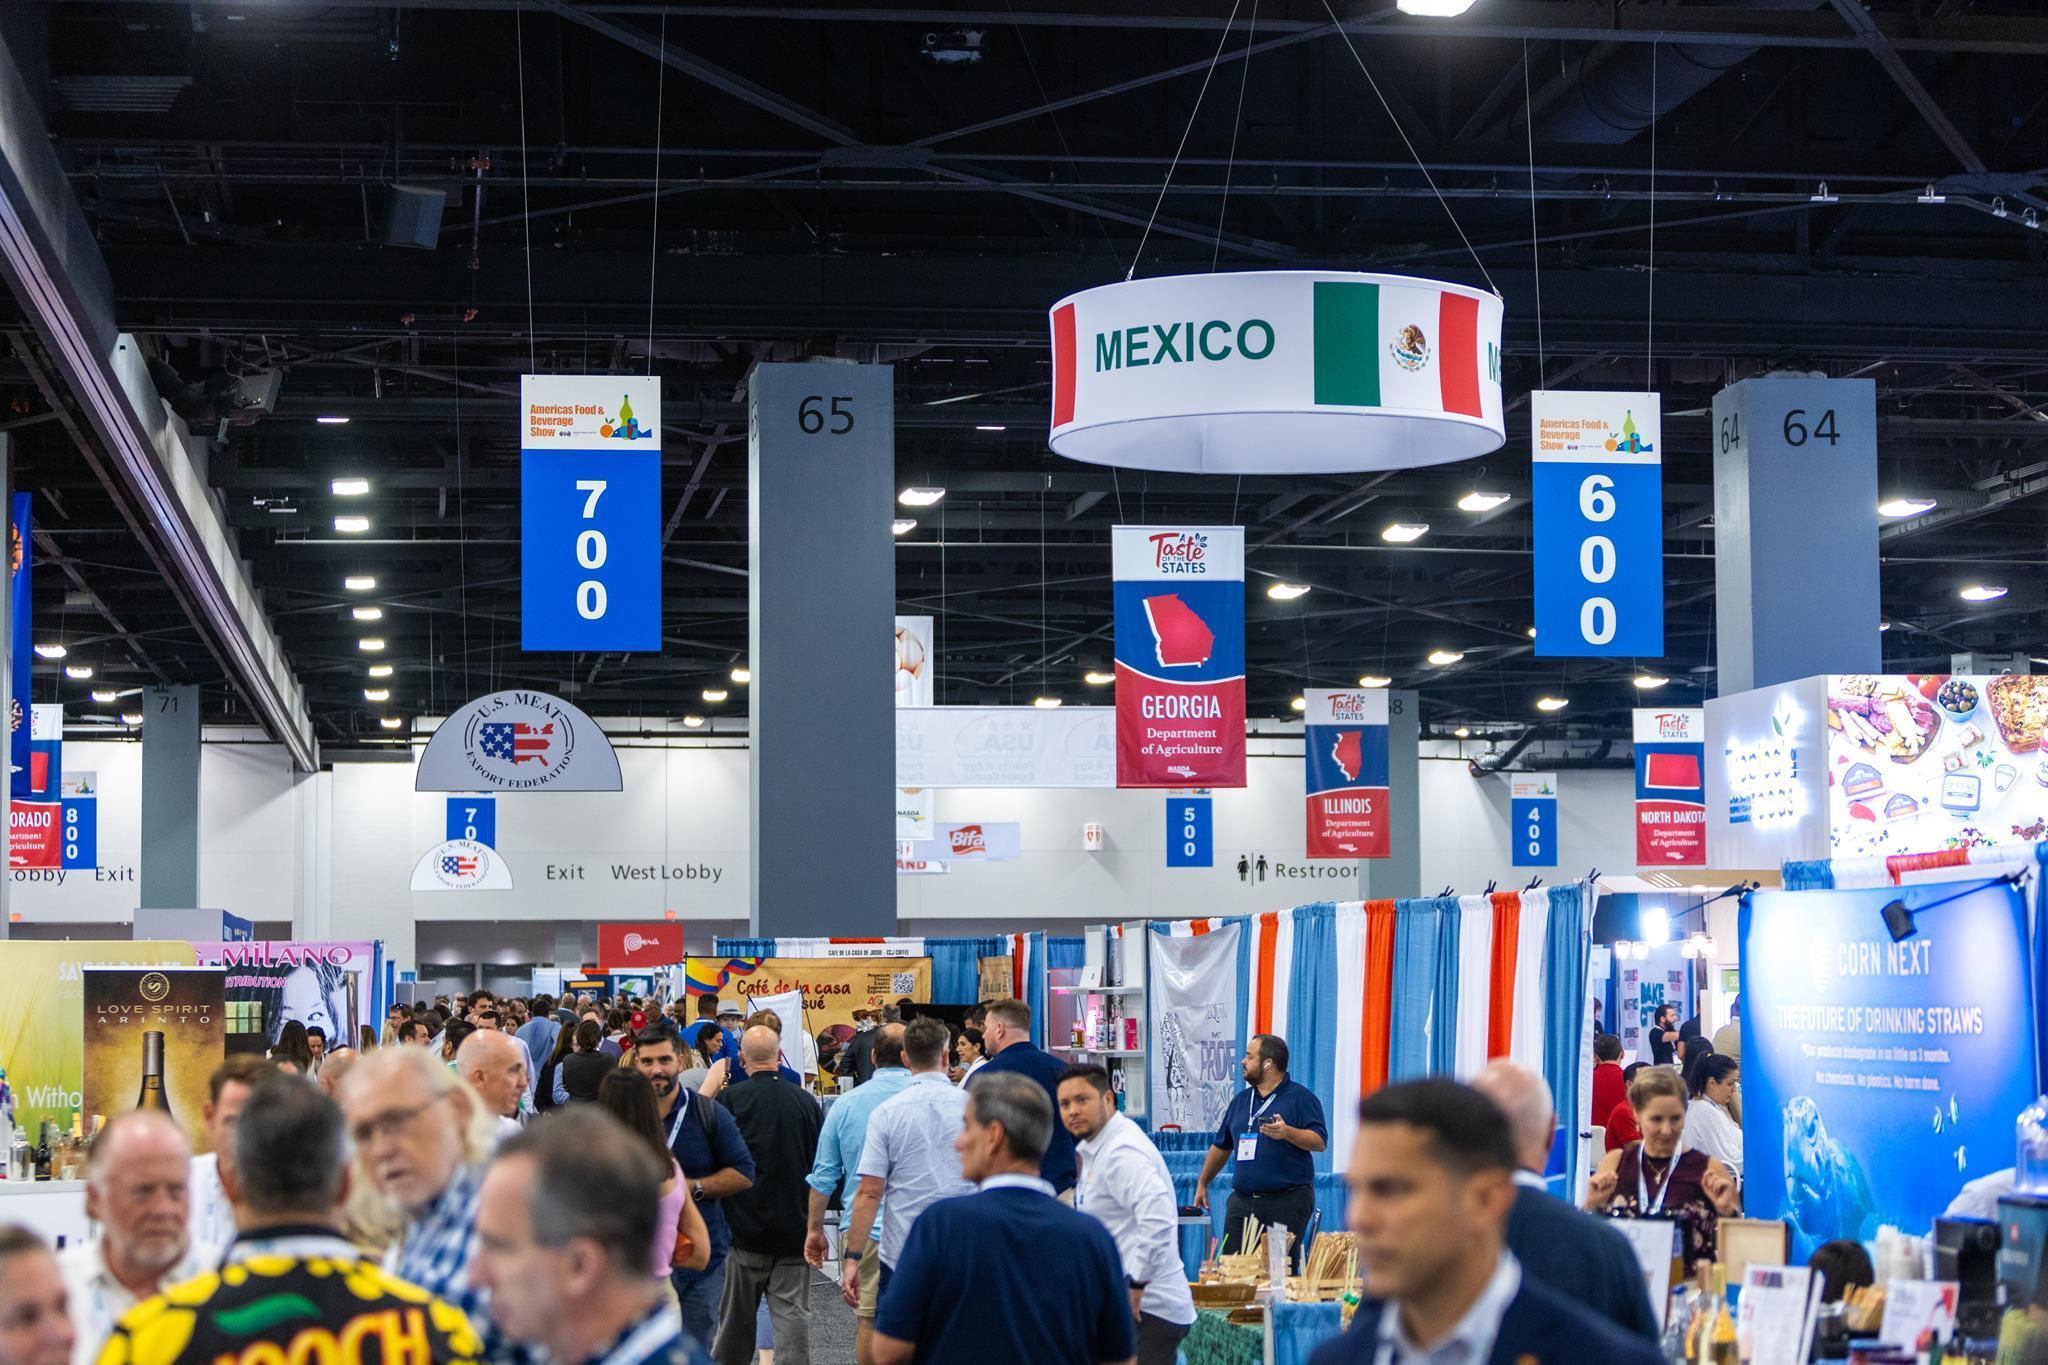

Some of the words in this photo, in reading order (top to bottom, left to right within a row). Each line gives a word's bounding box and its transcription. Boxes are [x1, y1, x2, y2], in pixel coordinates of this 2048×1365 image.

[1095, 319, 1276, 374] MEXICO
[530, 404, 573, 415] Americas
[575, 404, 597, 415] Food
[598, 405, 605, 415] &
[798, 395, 855, 435] 65
[530, 415, 574, 427] Beverage
[1540, 419, 1580, 429] Americas
[1581, 419, 1602, 430] Food
[1602, 420, 1609, 430] &
[1782, 409, 1841, 447] 64
[530, 427, 556, 437] Show
[1540, 429, 1581, 441] Beverage
[1720, 412, 1741, 455] 64
[1540, 441, 1564, 451] Show
[1180, 533, 1186, 543] A
[1148, 532, 1205, 568] Taste
[1161, 562, 1206, 573] STATES
[160, 696, 178, 713] 71
[477, 696, 509, 719] U.S.
[514, 692, 563, 720] MEAT
[1142, 694, 1222, 719] GEORGIA
[1328, 693, 1362, 717] Taste
[1336, 712, 1365, 720] STATES
[1654, 713, 1688, 735] Taste
[1146, 727, 1217, 742] Department
[1662, 730, 1689, 738] STATES
[1141, 743, 1155, 755] of
[1156, 743, 1223, 758] Agriculture
[466, 750, 506, 787] EXPORT
[508, 748, 574, 789] FEDERATION
[1324, 798, 1372, 814] ILLINOIS
[1326, 819, 1371, 829] Department
[1640, 811, 1671, 824] NORTH
[953, 829, 985, 847] Bifa
[1322, 829, 1331, 837] of
[1331, 829, 1375, 839] Agriculture
[1653, 829, 1696, 839] Department
[1650, 839, 1659, 847] of
[1660, 839, 1699, 848] Agriculture
[9, 868, 67, 886] obby
[96, 866, 135, 882] Exit
[546, 864, 585, 880] Exit
[611, 864, 657, 880] West
[661, 863, 722, 883] Lobby
[1837, 941, 1881, 977] CORN
[1887, 939, 1932, 977] NEXT
[736, 978, 770, 995] Café
[774, 979, 791, 994] de
[795, 979, 810, 994] la
[814, 982, 851, 995] casa
[97, 1005, 144, 1014] LOVE
[151, 1005, 211, 1014] SPIRIT
[1777, 1005, 1800, 1030] THE
[1800, 1006, 1845, 1032] FUTURE
[1847, 1007, 1863, 1033] OF
[1865, 1007, 1925, 1034] DRINKING
[1926, 1006, 1984, 1035] STRAWS
[26, 1085, 83, 1108] Witho
